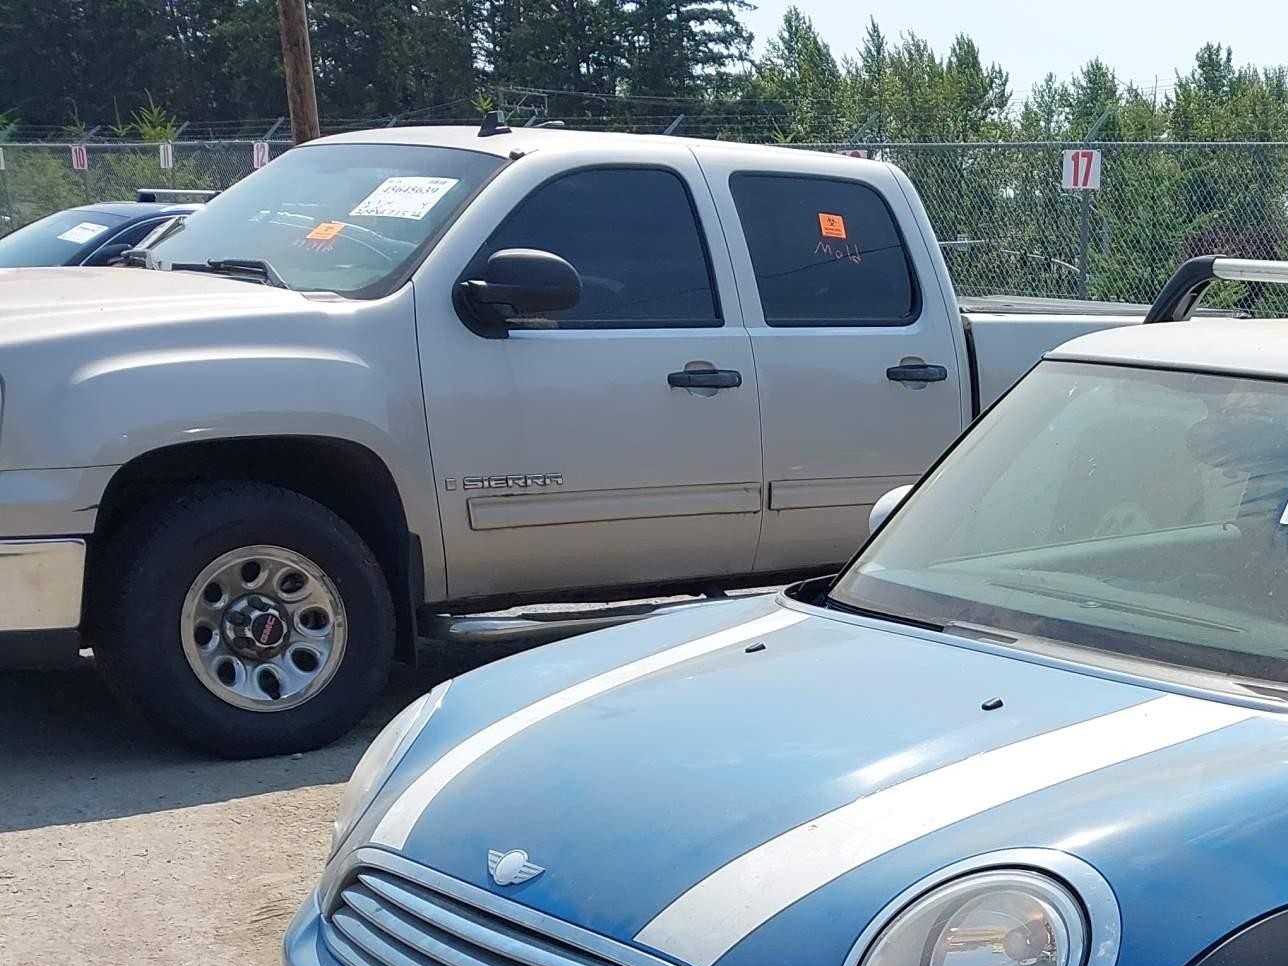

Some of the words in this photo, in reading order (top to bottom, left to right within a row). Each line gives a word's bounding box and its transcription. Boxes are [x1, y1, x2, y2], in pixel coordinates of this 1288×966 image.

[74, 146, 86, 168] 10
[1071, 151, 1093, 187] 17
[463, 473, 563, 490] SIERRA
[261, 615, 276, 643] GMC
